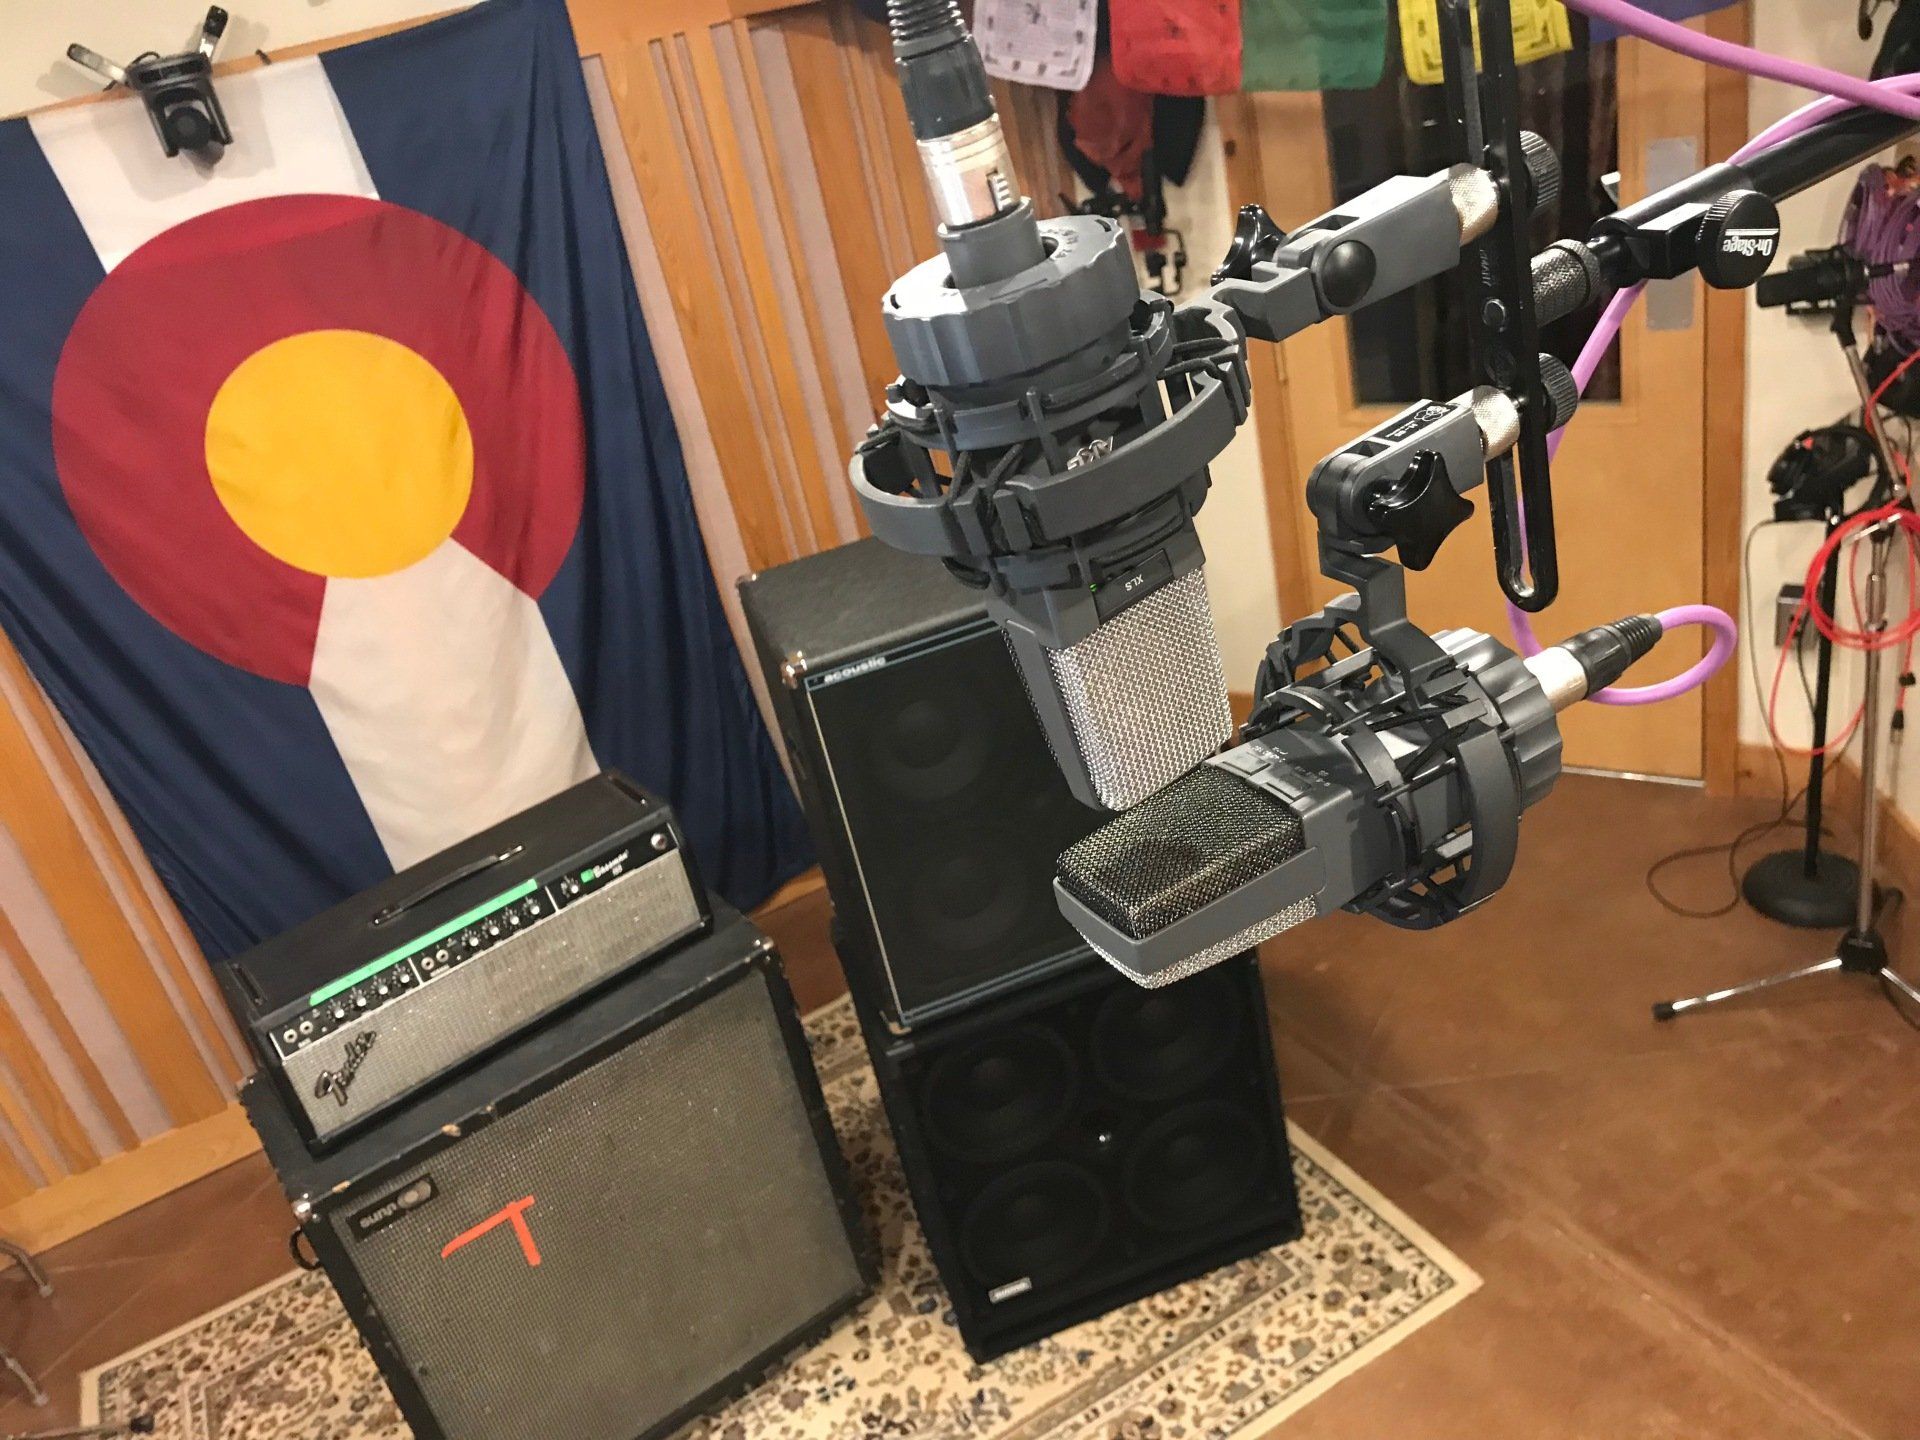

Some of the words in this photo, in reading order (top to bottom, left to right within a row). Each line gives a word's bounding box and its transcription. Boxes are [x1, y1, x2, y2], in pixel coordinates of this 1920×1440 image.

[1125, 574, 1143, 591] XLS
[824, 656, 886, 685] acoustic
[315, 1031, 376, 1106] Fender
[360, 1202, 397, 1228] sunn
